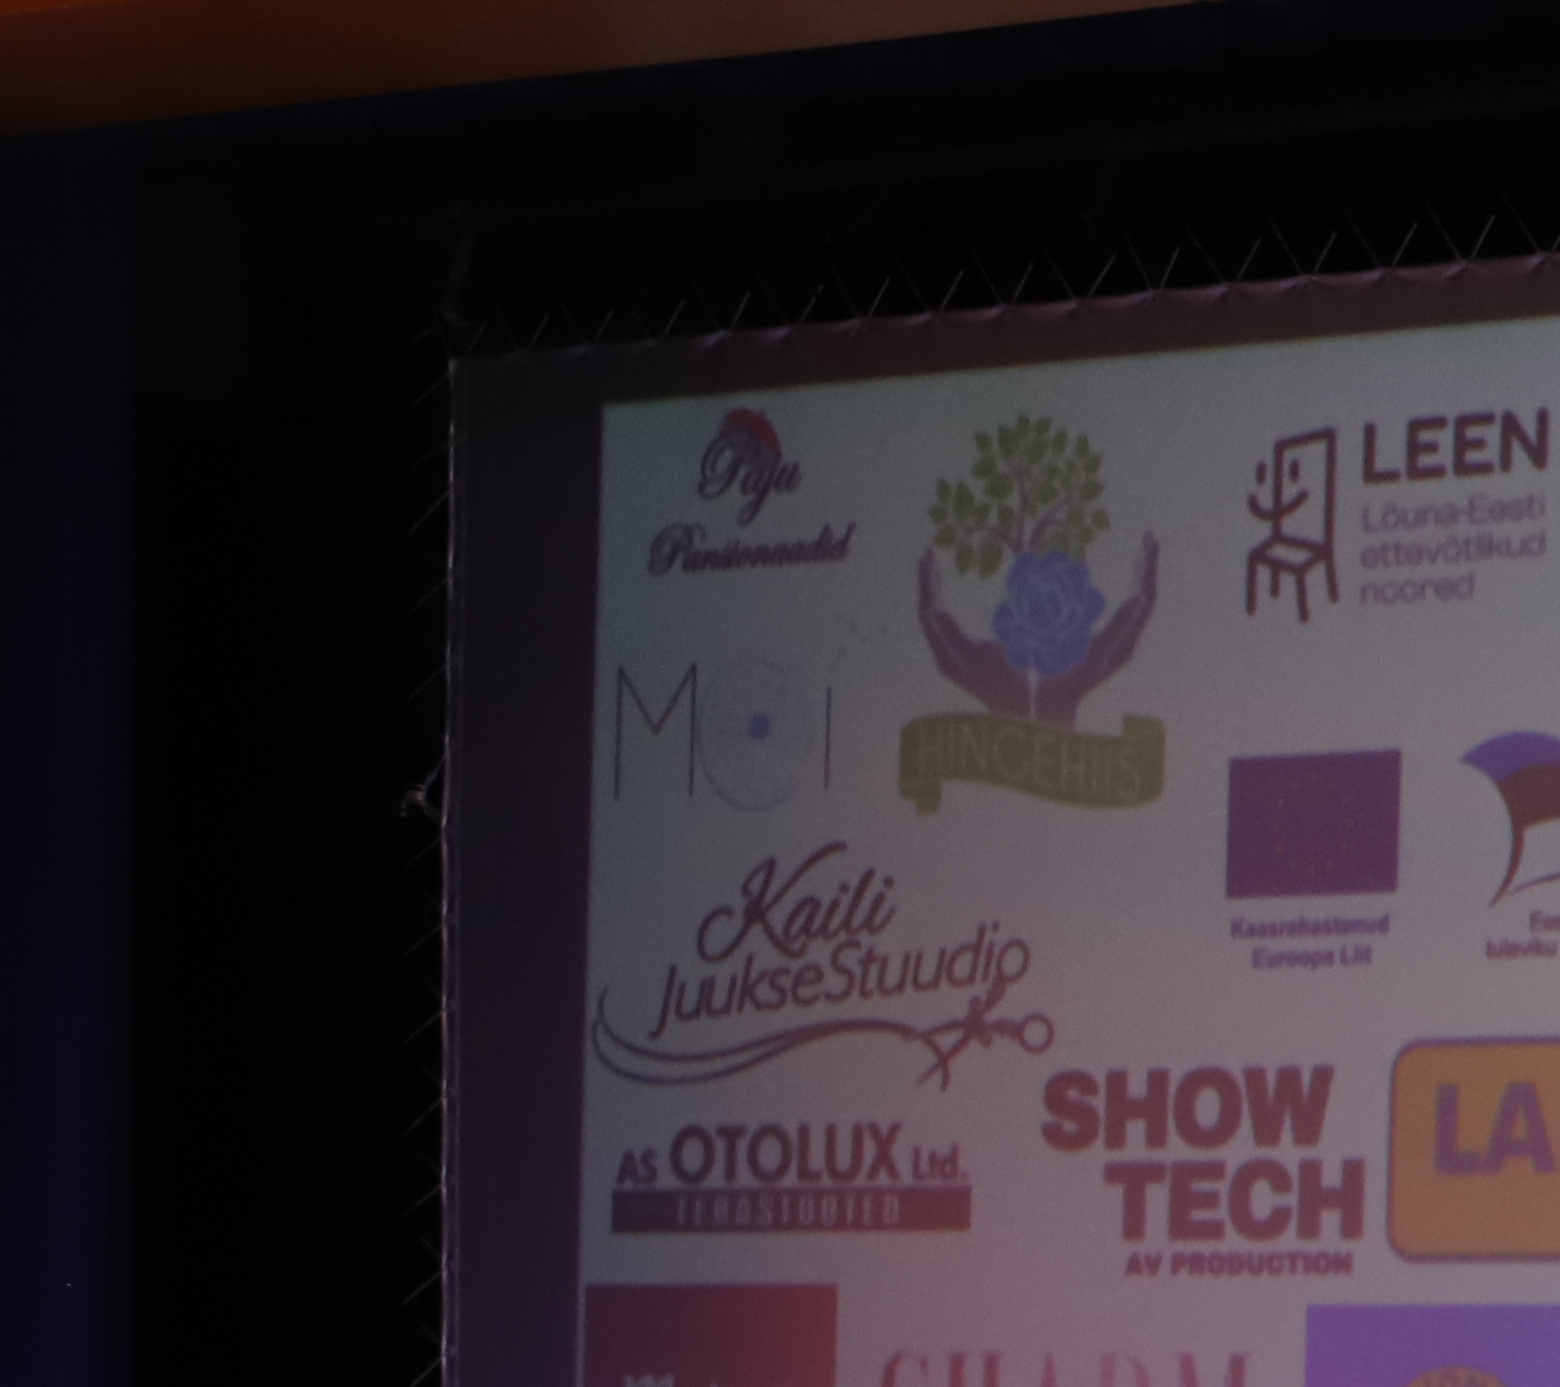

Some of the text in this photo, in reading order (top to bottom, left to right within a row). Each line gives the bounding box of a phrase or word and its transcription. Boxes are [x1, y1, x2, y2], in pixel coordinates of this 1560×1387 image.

[1361, 404, 1552, 487] LEEN
[1360, 492, 1547, 534] Lõuna-Eesti
[1359, 530, 1547, 571] ettevõtlikud
[1359, 570, 1477, 606] noored
[696, 840, 896, 966] Kaili
[1040, 1064, 1337, 1152] SHOW
[616, 1148, 658, 1185] AS
[670, 1120, 904, 1186] OTOLUX
[1104, 1158, 1365, 1243] TECH
[1124, 1249, 1353, 1279] AV PRODUCTION
